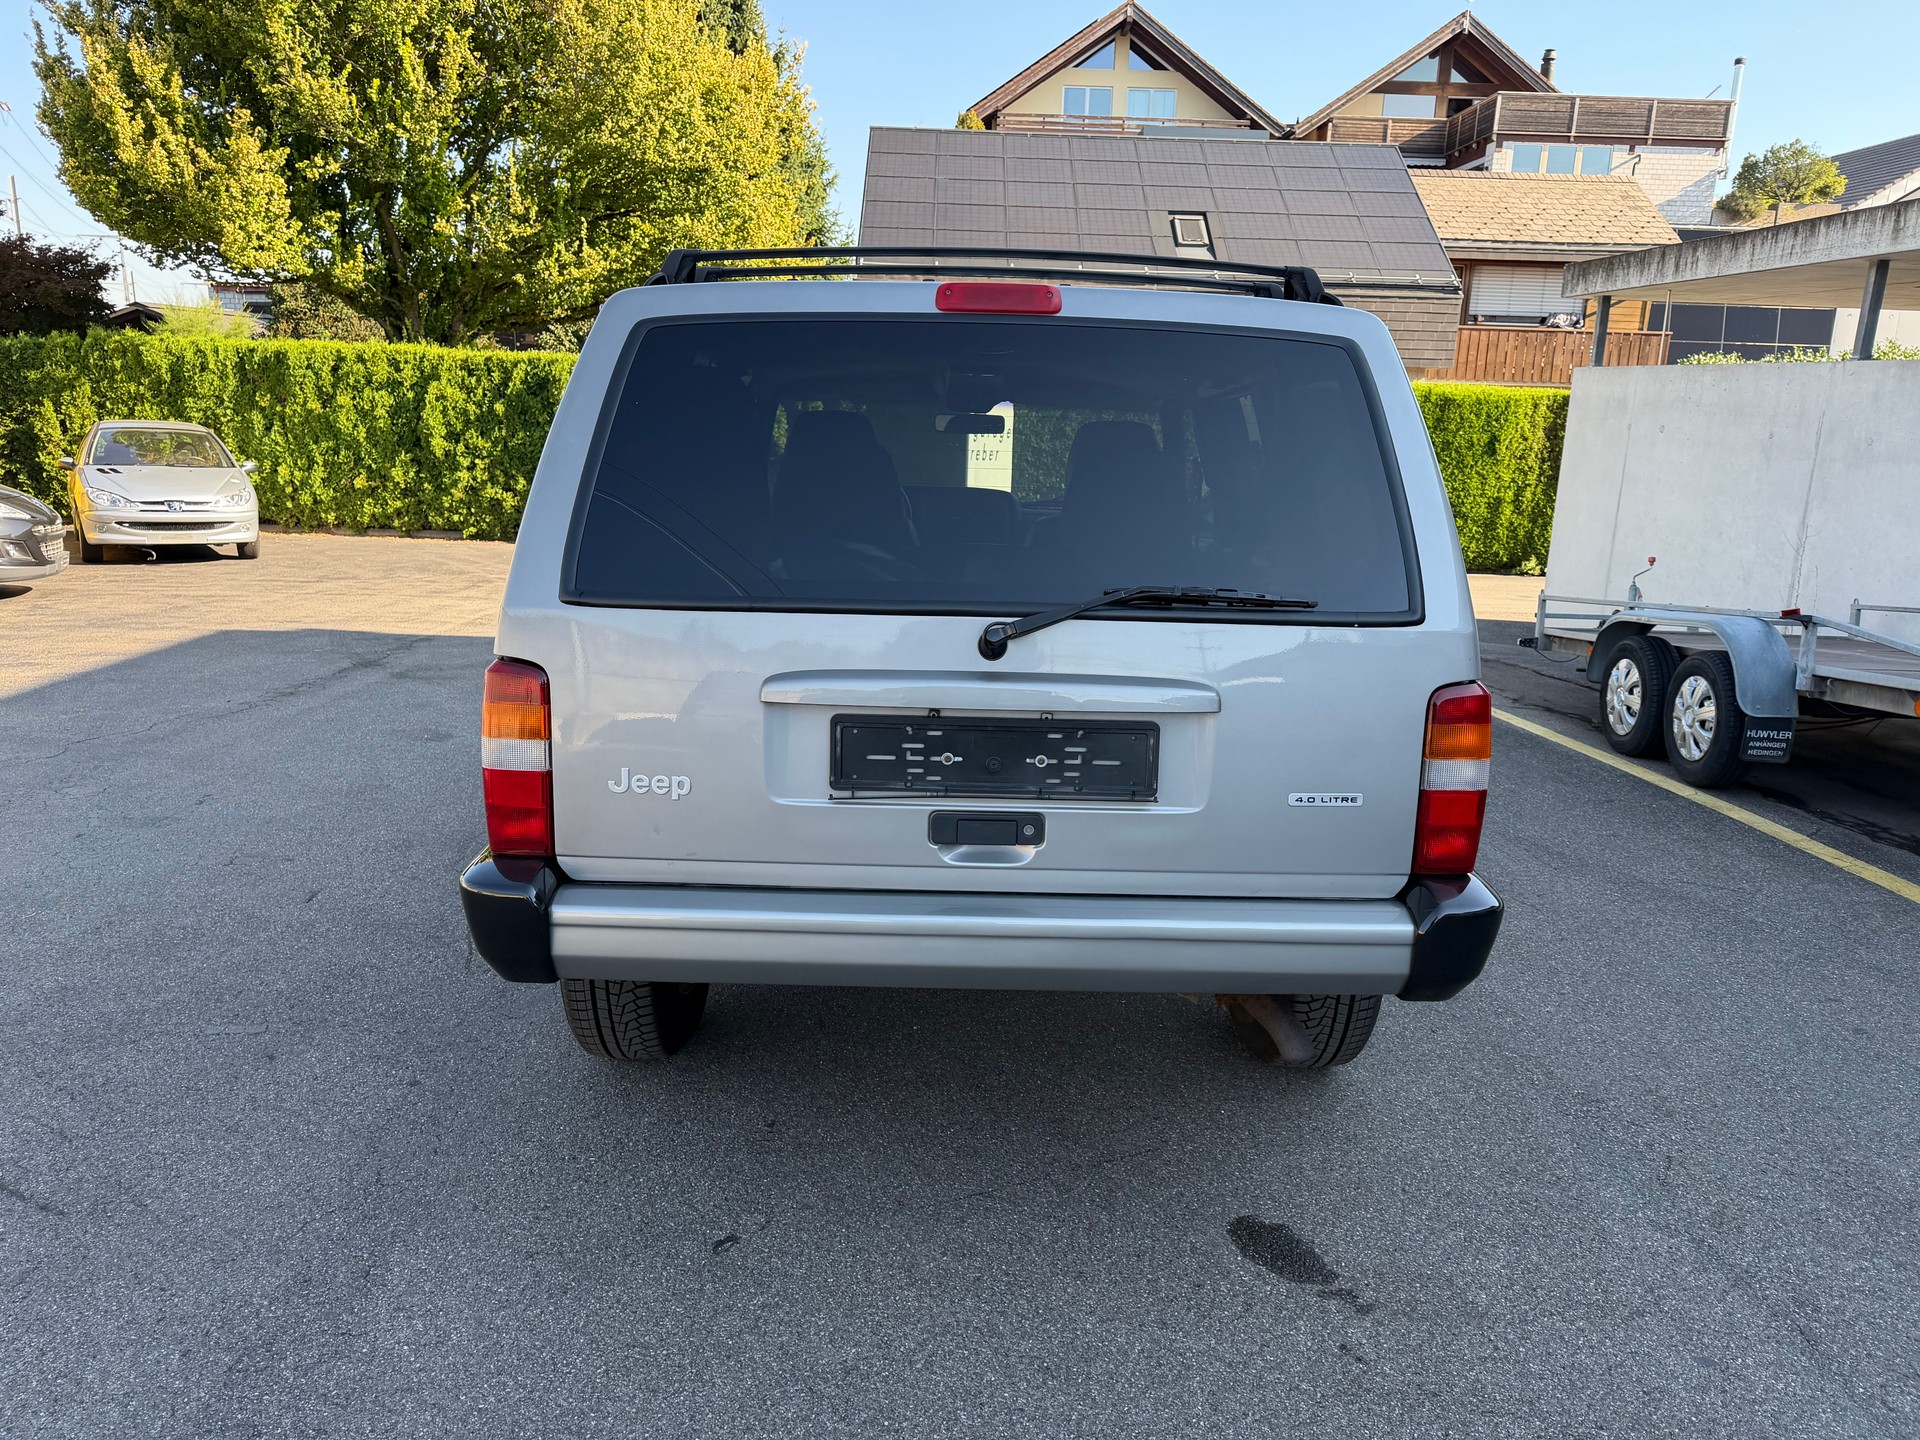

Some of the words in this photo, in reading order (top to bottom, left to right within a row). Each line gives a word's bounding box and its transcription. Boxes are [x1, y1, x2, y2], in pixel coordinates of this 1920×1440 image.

[970, 443, 999, 461] reber
[1747, 730, 1792, 739] HUWYLER
[1749, 740, 1786, 748] ANHÄNGER
[608, 767, 692, 801] Jeep
